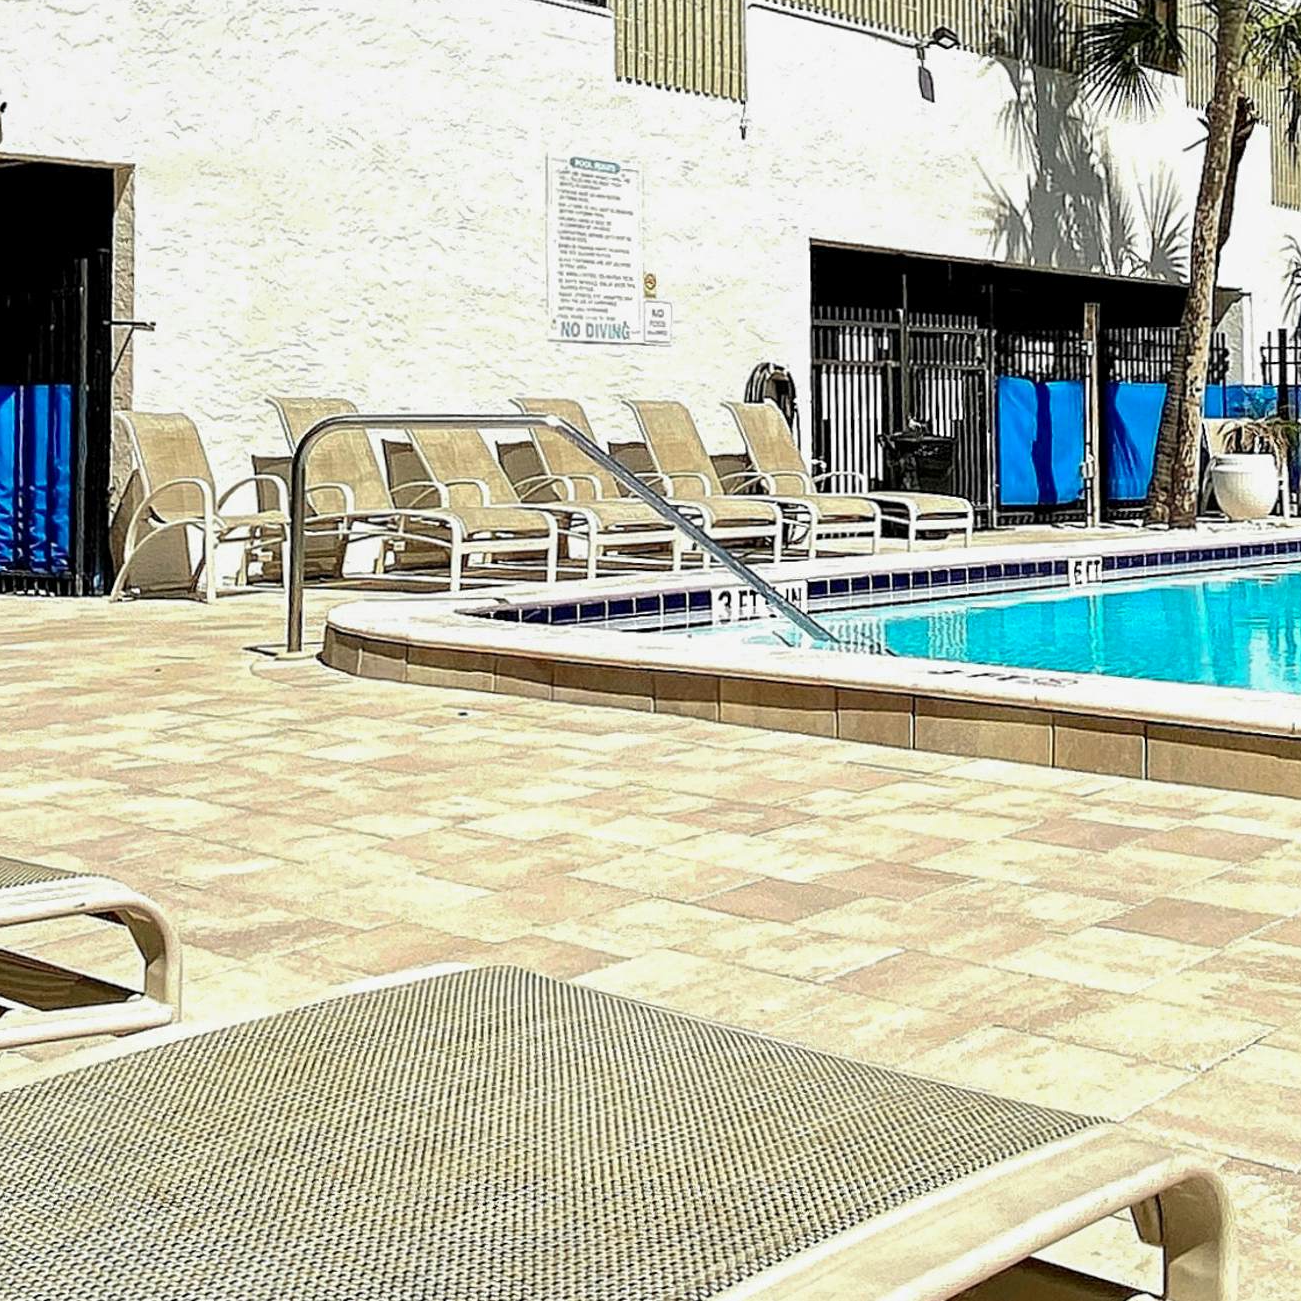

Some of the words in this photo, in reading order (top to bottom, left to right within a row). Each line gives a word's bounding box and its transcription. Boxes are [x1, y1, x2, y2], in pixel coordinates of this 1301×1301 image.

[560, 320, 581, 338] NO
[585, 322, 631, 340] DIVING
[717, 590, 732, 623] 3
[738, 589, 762, 621] FT
